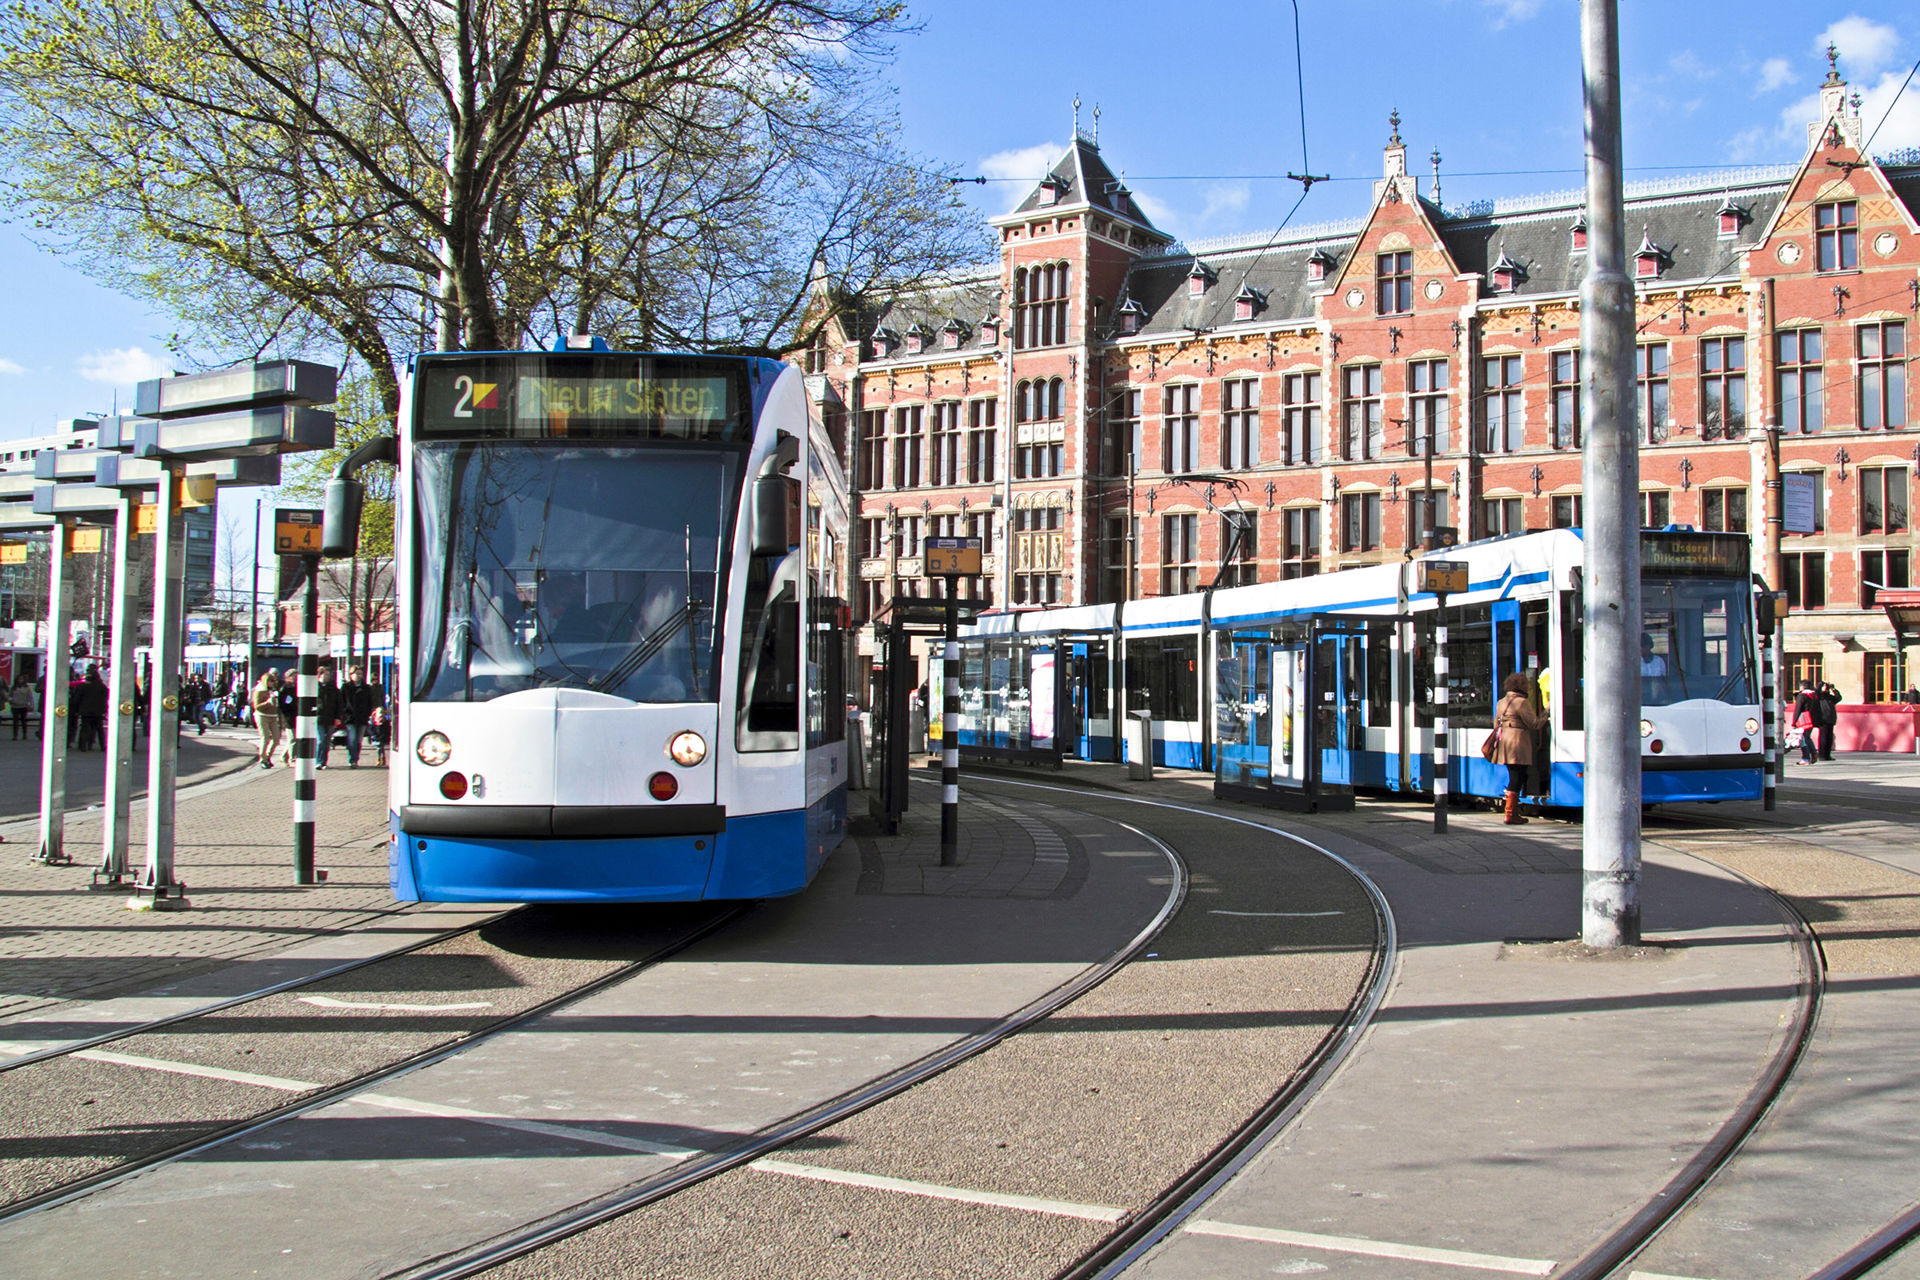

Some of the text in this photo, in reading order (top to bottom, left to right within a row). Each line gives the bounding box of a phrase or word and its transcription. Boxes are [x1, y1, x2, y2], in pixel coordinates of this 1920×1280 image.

[453, 375, 473, 418] 2
[530, 377, 714, 415] Nieuw Sloten
[303, 530, 311, 546] 4
[951, 555, 957, 568] 3
[1445, 574, 1451, 586] 2
